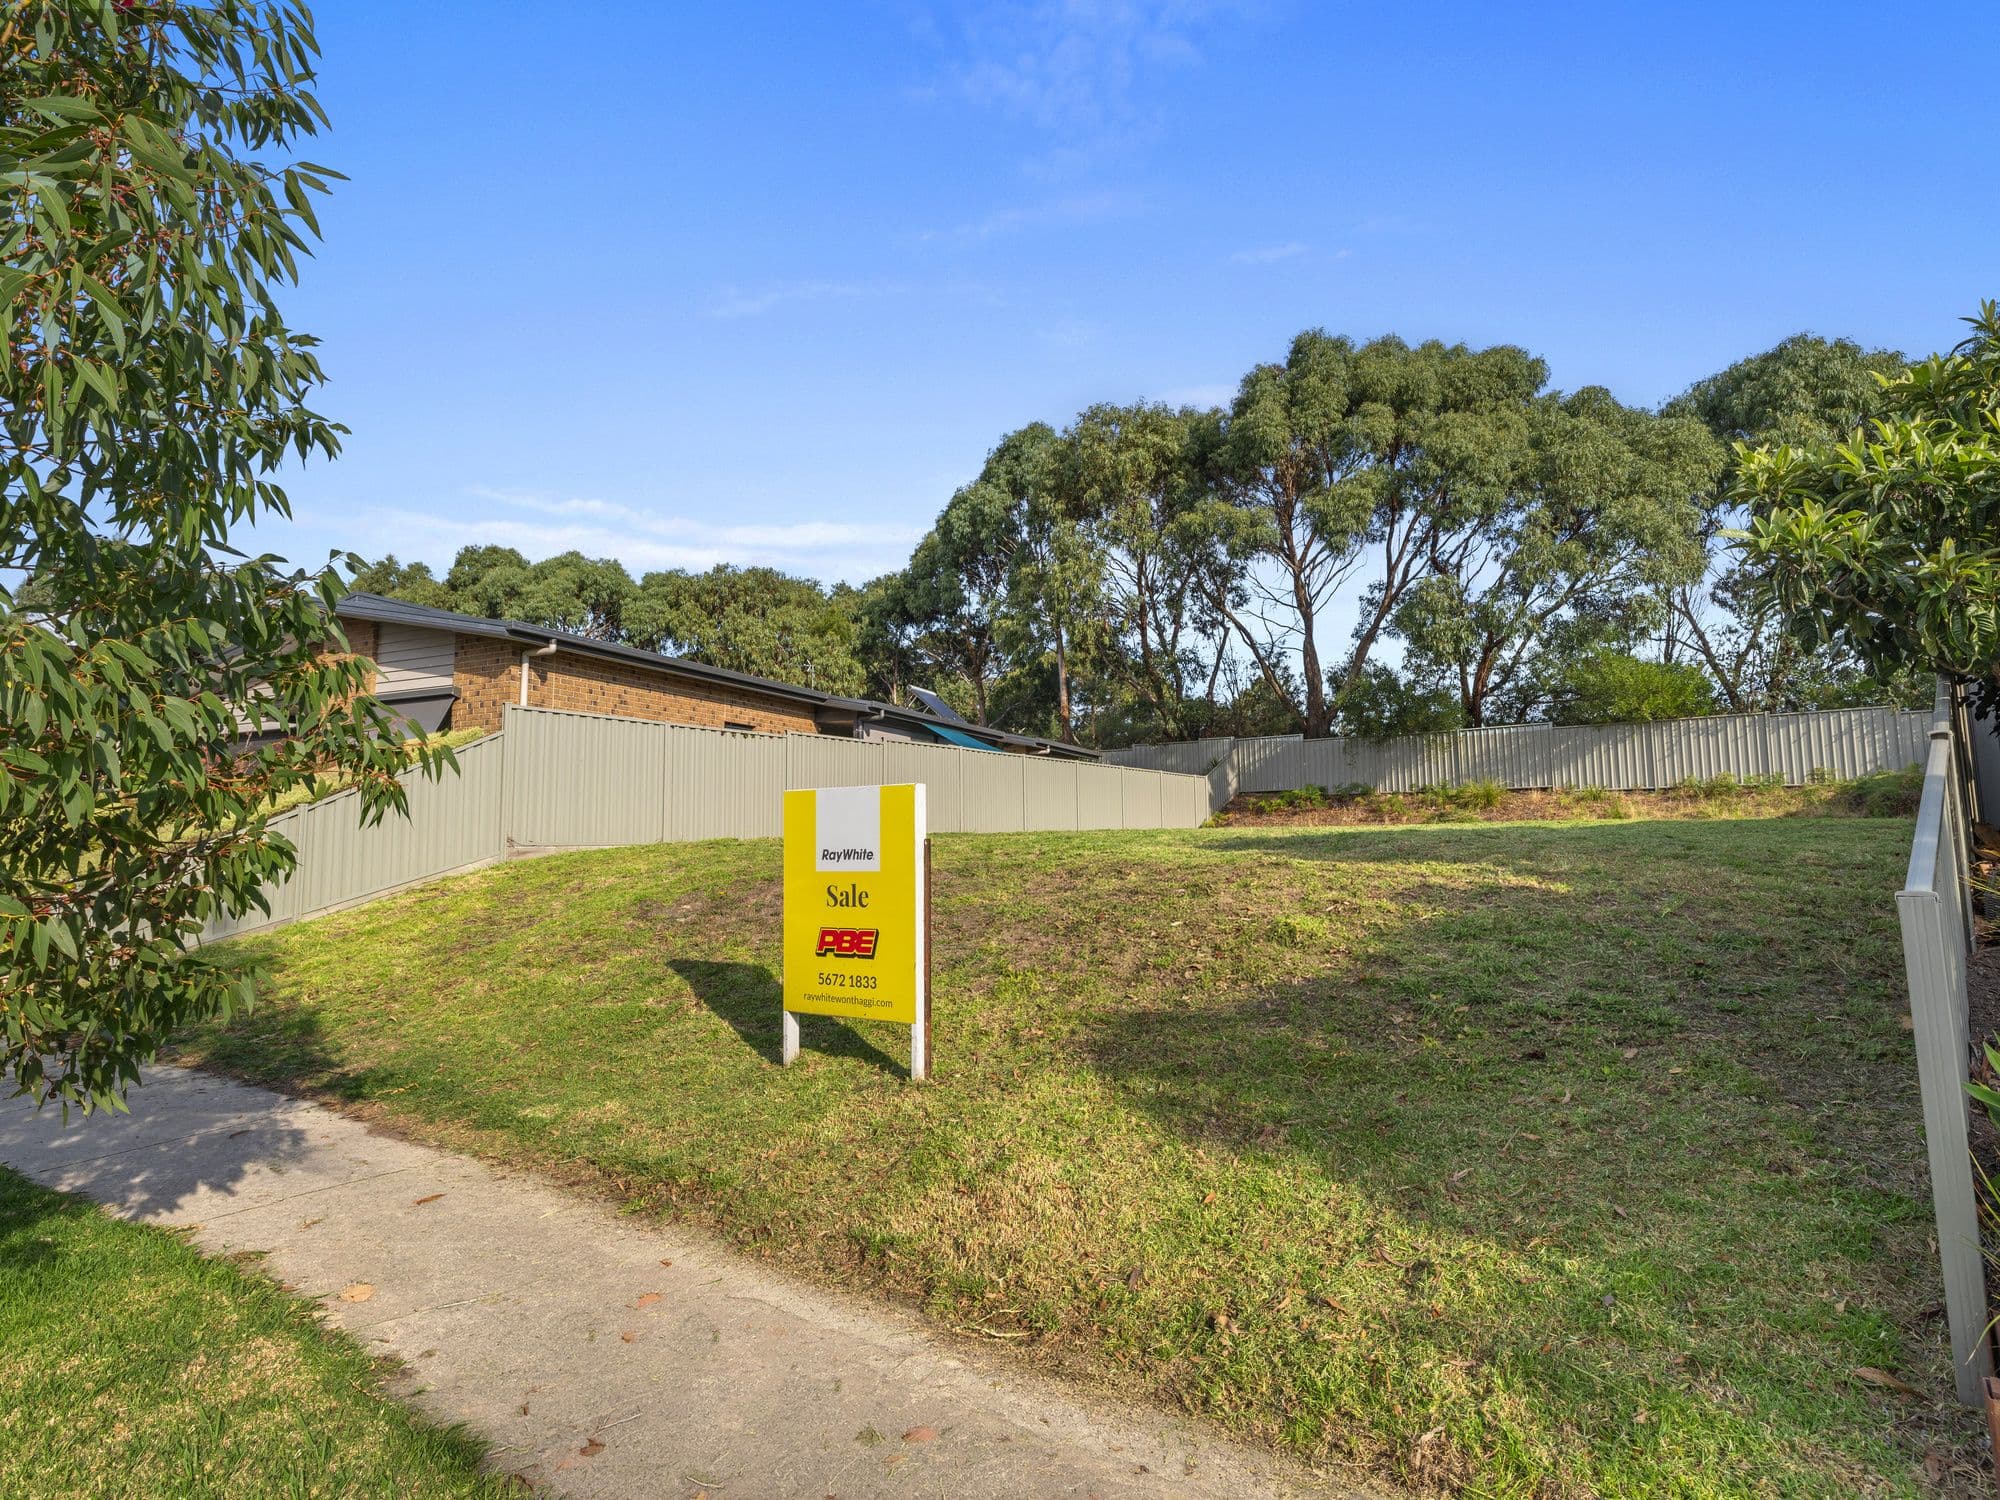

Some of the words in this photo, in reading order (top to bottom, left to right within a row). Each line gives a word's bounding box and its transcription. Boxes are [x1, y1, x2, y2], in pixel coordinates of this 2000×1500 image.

[826, 884, 869, 908] Sale
[815, 927, 880, 960] PBE
[818, 972, 845, 987] 5672
[848, 975, 877, 989] 1833
[803, 992, 893, 1008] raywhitewonthaggi.com
